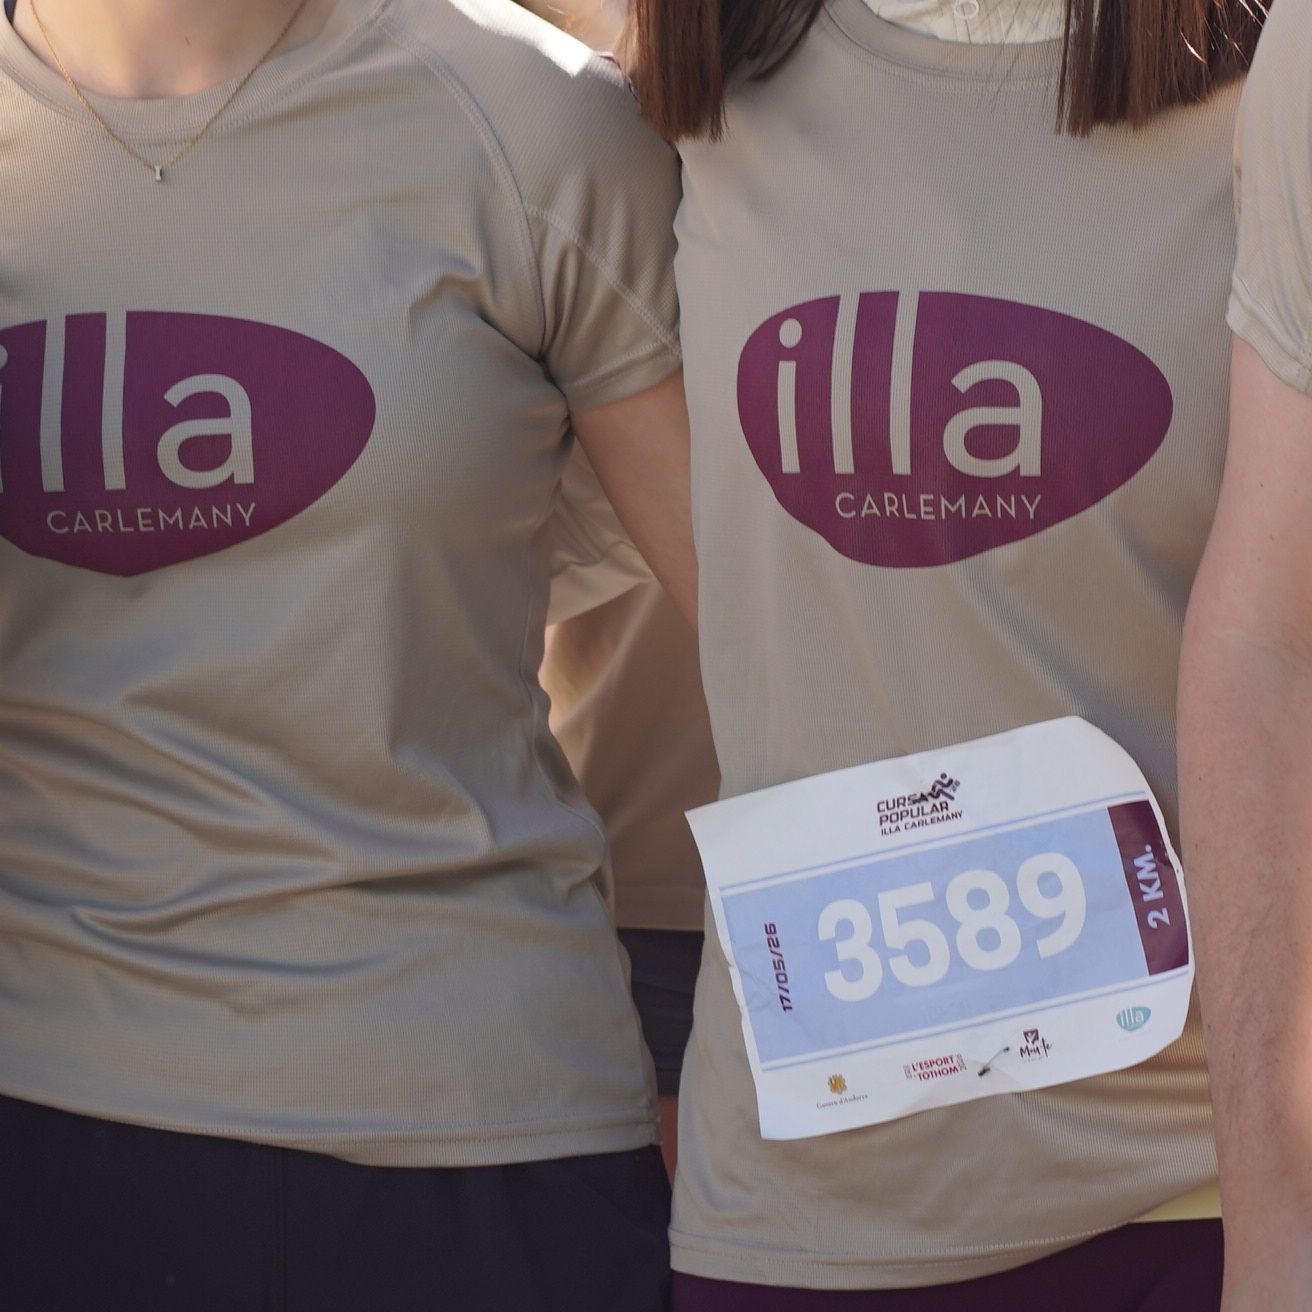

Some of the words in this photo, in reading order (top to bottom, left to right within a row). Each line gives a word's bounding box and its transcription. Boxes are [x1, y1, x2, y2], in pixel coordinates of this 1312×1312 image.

[777, 289, 1043, 477] illa
[47, 502, 258, 535] CARLEMANY
[835, 493, 1043, 522] CARLEMANY
[879, 800, 949, 826] POPULAR
[904, 810, 963, 830] CARLEMANY
[1132, 842, 1166, 907] KM.
[817, 852, 1087, 1003] 3589
[1146, 907, 1170, 930] 2
[764, 921, 793, 1013] 17/05/26
[917, 1065, 959, 1081] TOTHOM
